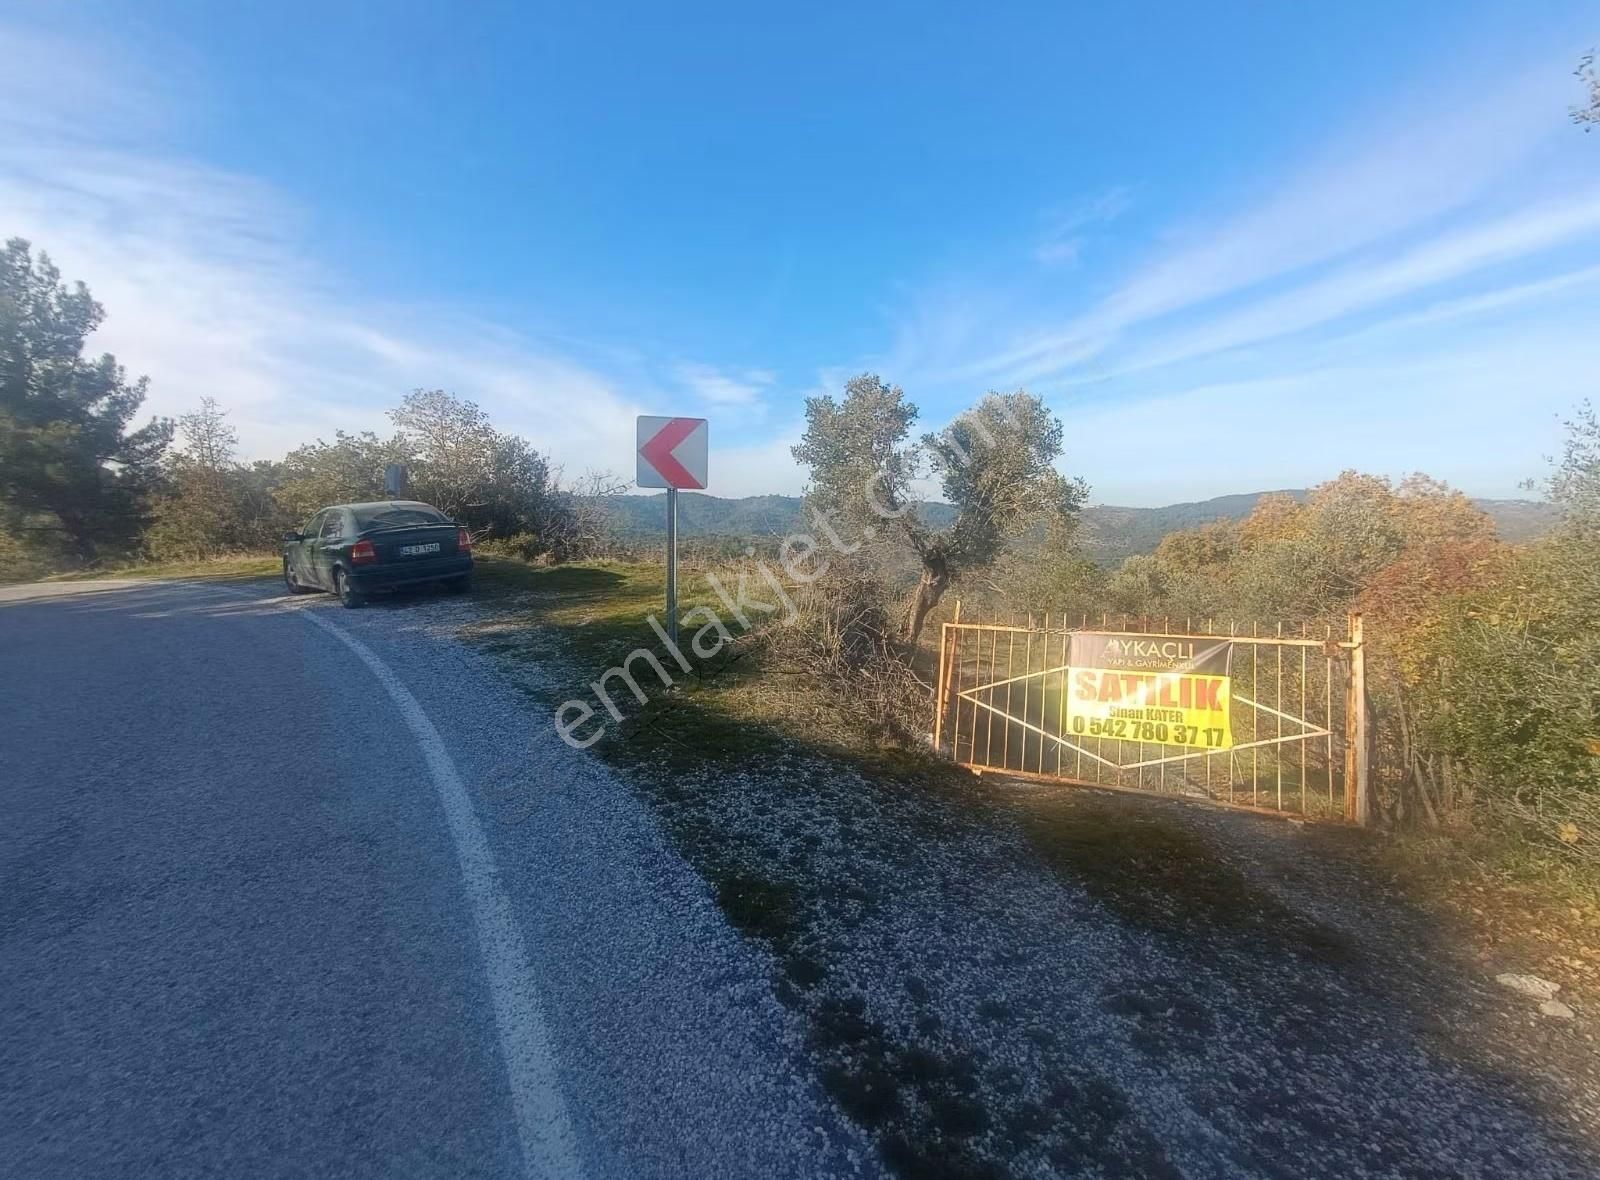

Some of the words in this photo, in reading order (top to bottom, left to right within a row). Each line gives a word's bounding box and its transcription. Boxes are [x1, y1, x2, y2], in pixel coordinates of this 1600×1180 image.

[1075, 671, 1223, 711] SATILIK
[1109, 705, 1144, 720] Sinan
[1145, 707, 1184, 723] KATER
[1072, 715, 1085, 734] 0
[1089, 716, 1127, 738] 542
[1131, 720, 1169, 742] 780
[1174, 724, 1199, 745] 37
[1202, 727, 1224, 747] 17
